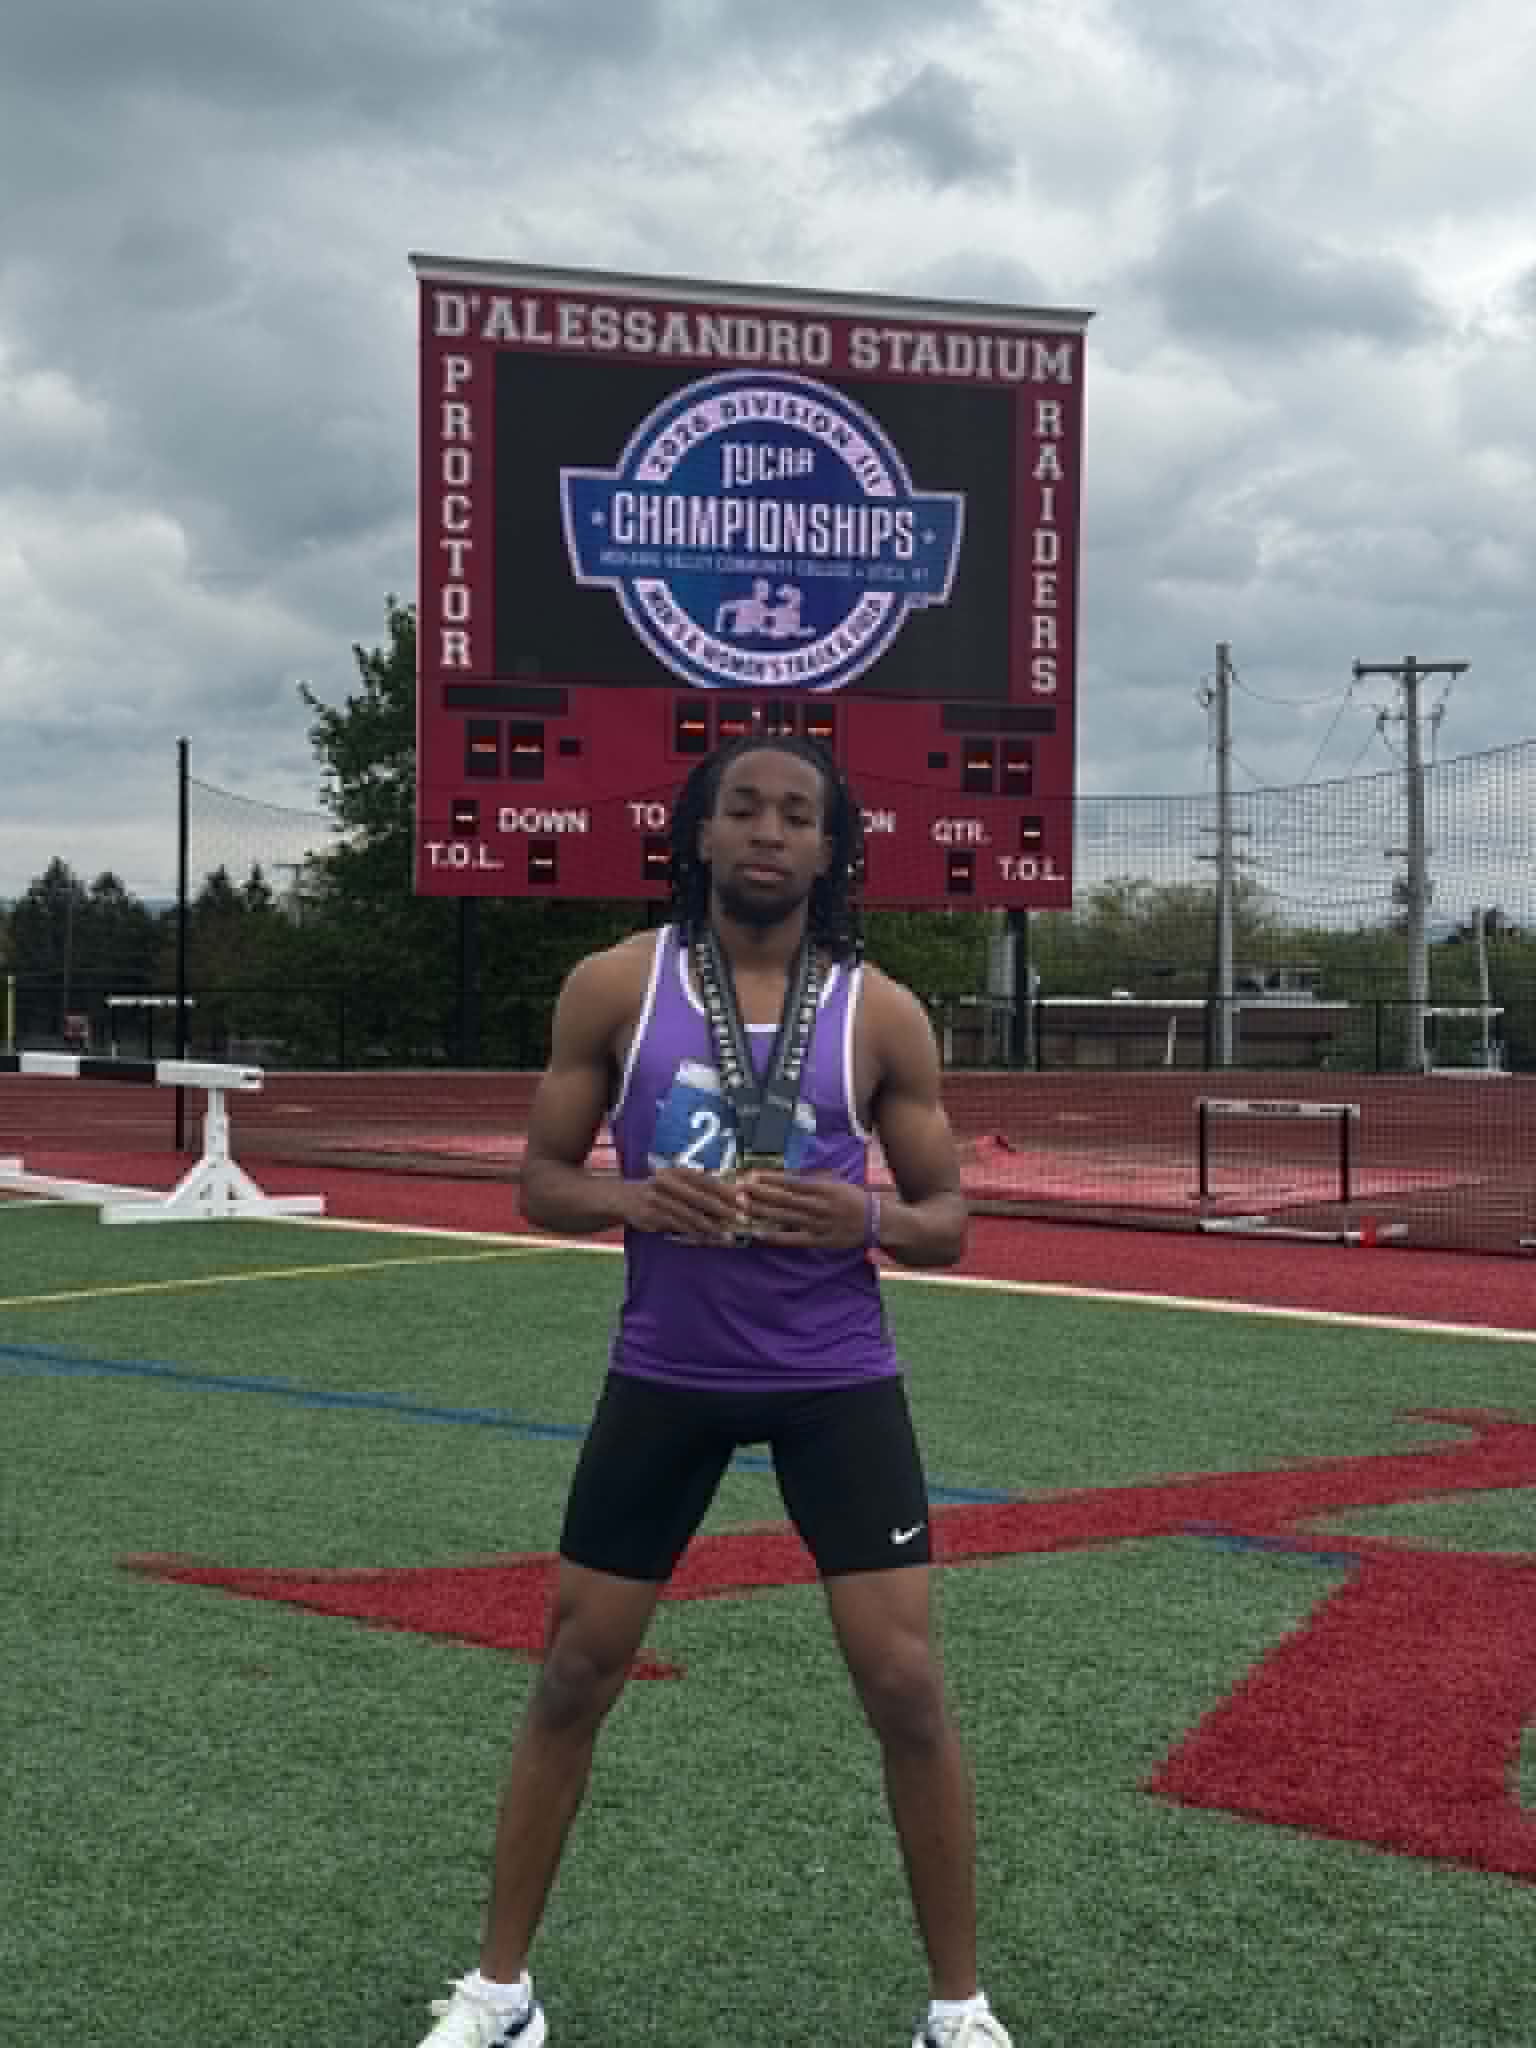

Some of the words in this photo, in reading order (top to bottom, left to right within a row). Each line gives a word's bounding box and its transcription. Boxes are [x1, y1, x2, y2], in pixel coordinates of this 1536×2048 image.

[433, 290, 833, 365] D'ALESSANDRO
[848, 327, 1074, 384] STADIUM
[720, 395, 856, 449] DIVISION
[440, 351, 472, 671] PROCTOR
[611, 491, 914, 560] CHAMPIONSHIPS
[1031, 400, 1064, 696] RAIDERS
[497, 807, 590, 833] DOWN
[627, 801, 667, 831] TO
